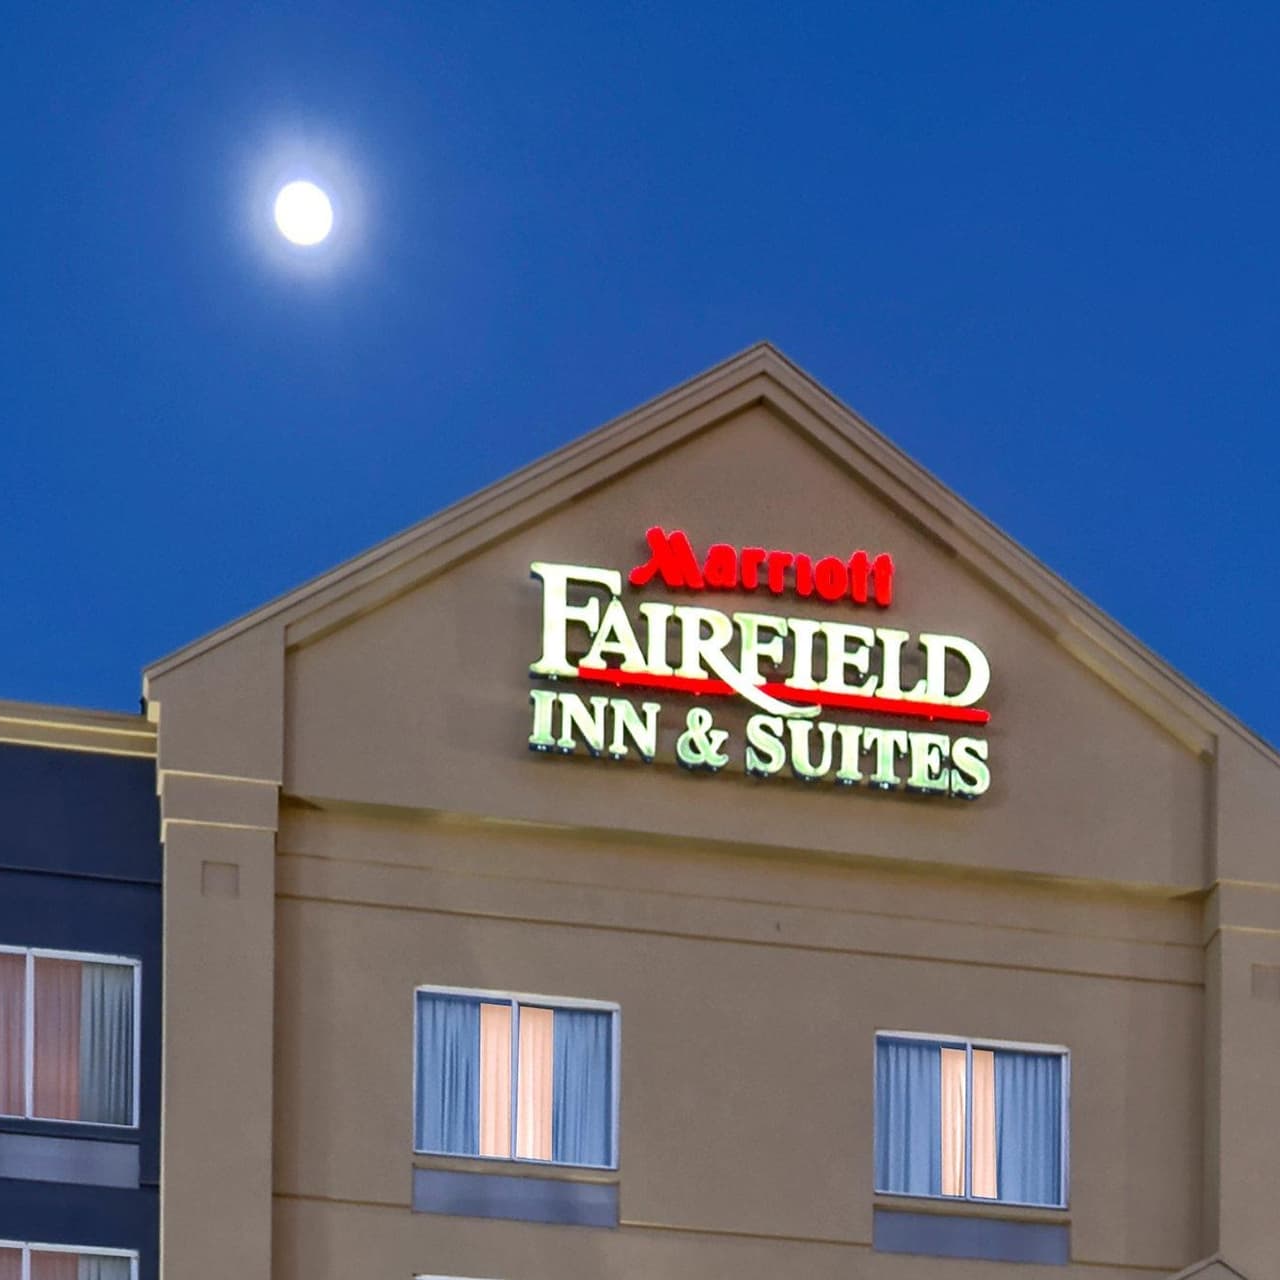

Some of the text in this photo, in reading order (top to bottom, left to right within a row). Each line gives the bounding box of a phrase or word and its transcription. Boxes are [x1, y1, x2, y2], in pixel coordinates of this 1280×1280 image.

[629, 526, 895, 607] Marriott
[530, 561, 991, 718] FAIRFIELD
[529, 689, 991, 799] INN & SUITES
